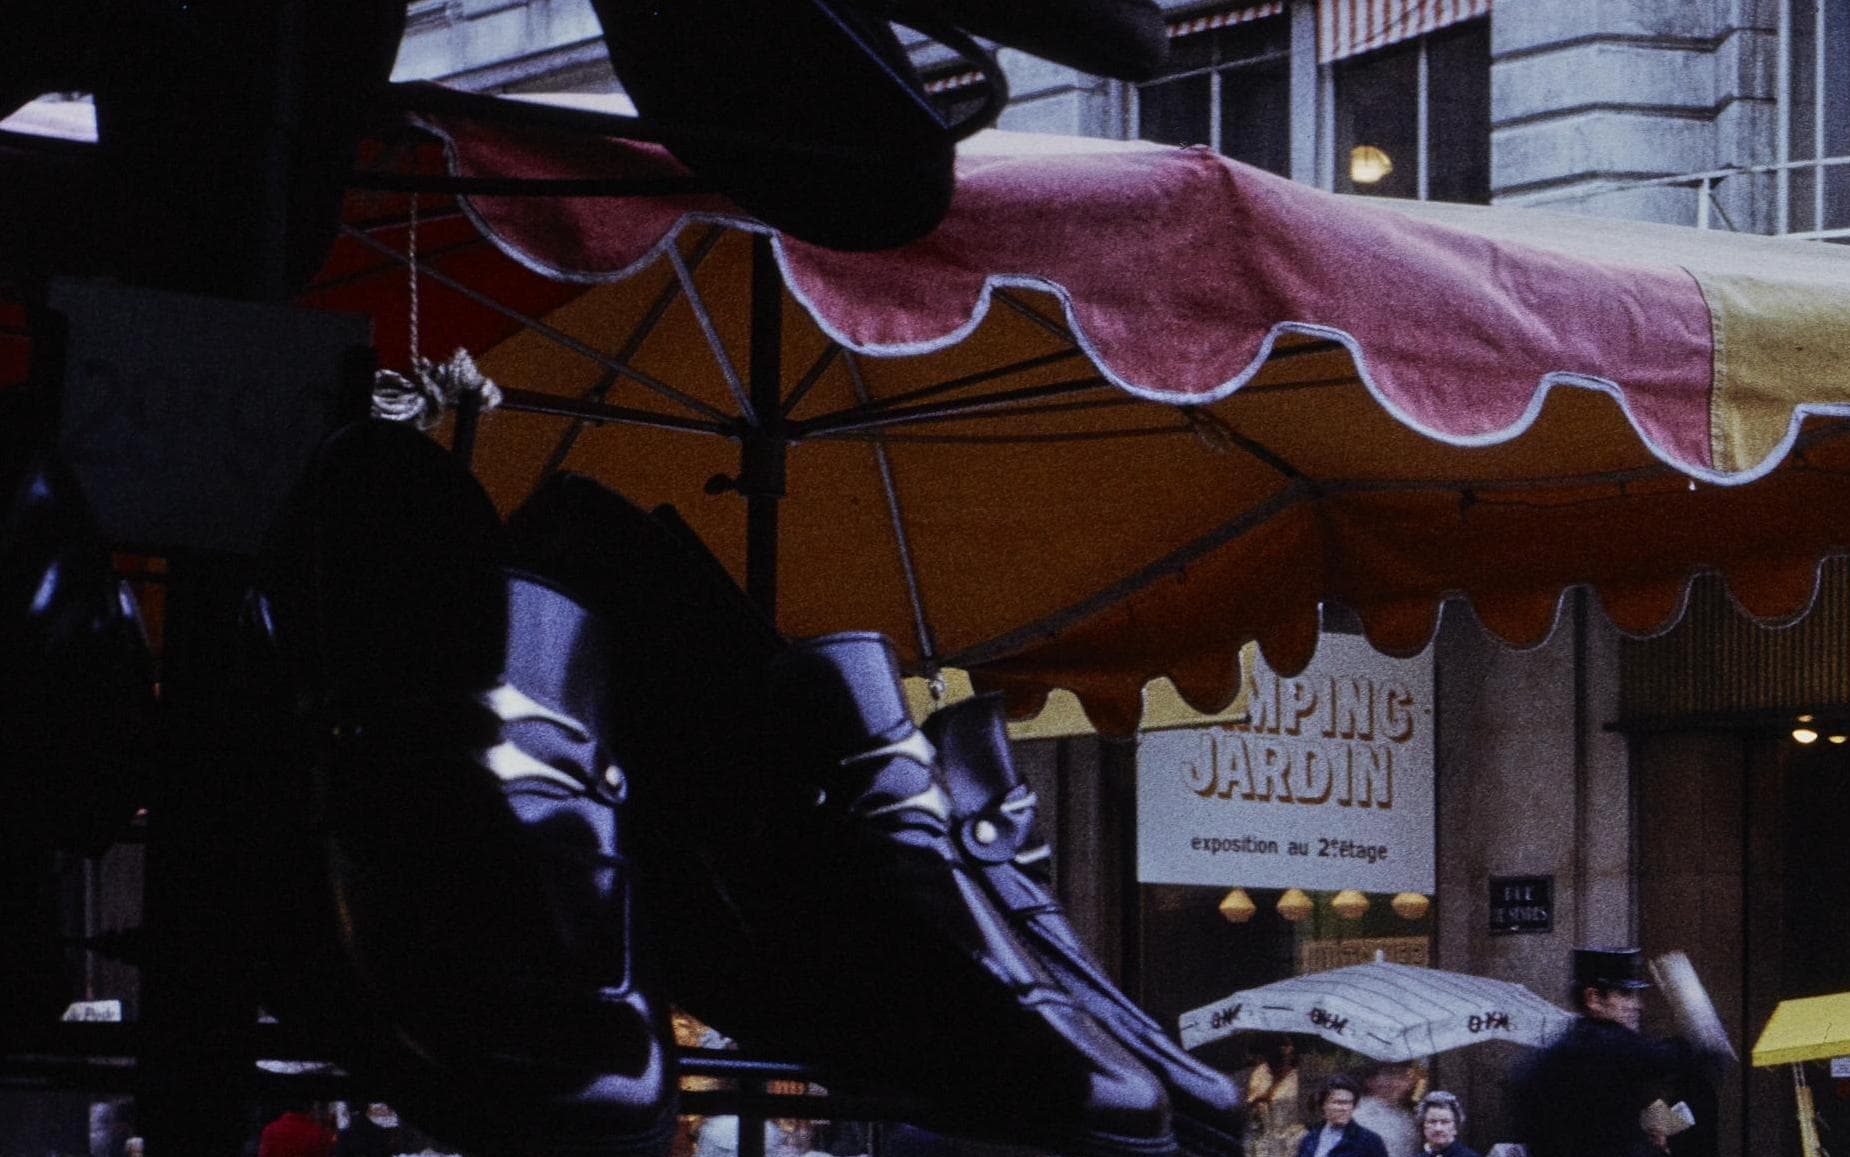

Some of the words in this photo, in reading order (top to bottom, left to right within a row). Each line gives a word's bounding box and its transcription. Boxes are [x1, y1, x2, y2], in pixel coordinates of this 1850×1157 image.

[1222, 672, 1414, 743] MPING
[1180, 733, 1393, 808] JARDIN
[1191, 835, 1278, 857] exposition
[1288, 842, 1310, 857] au
